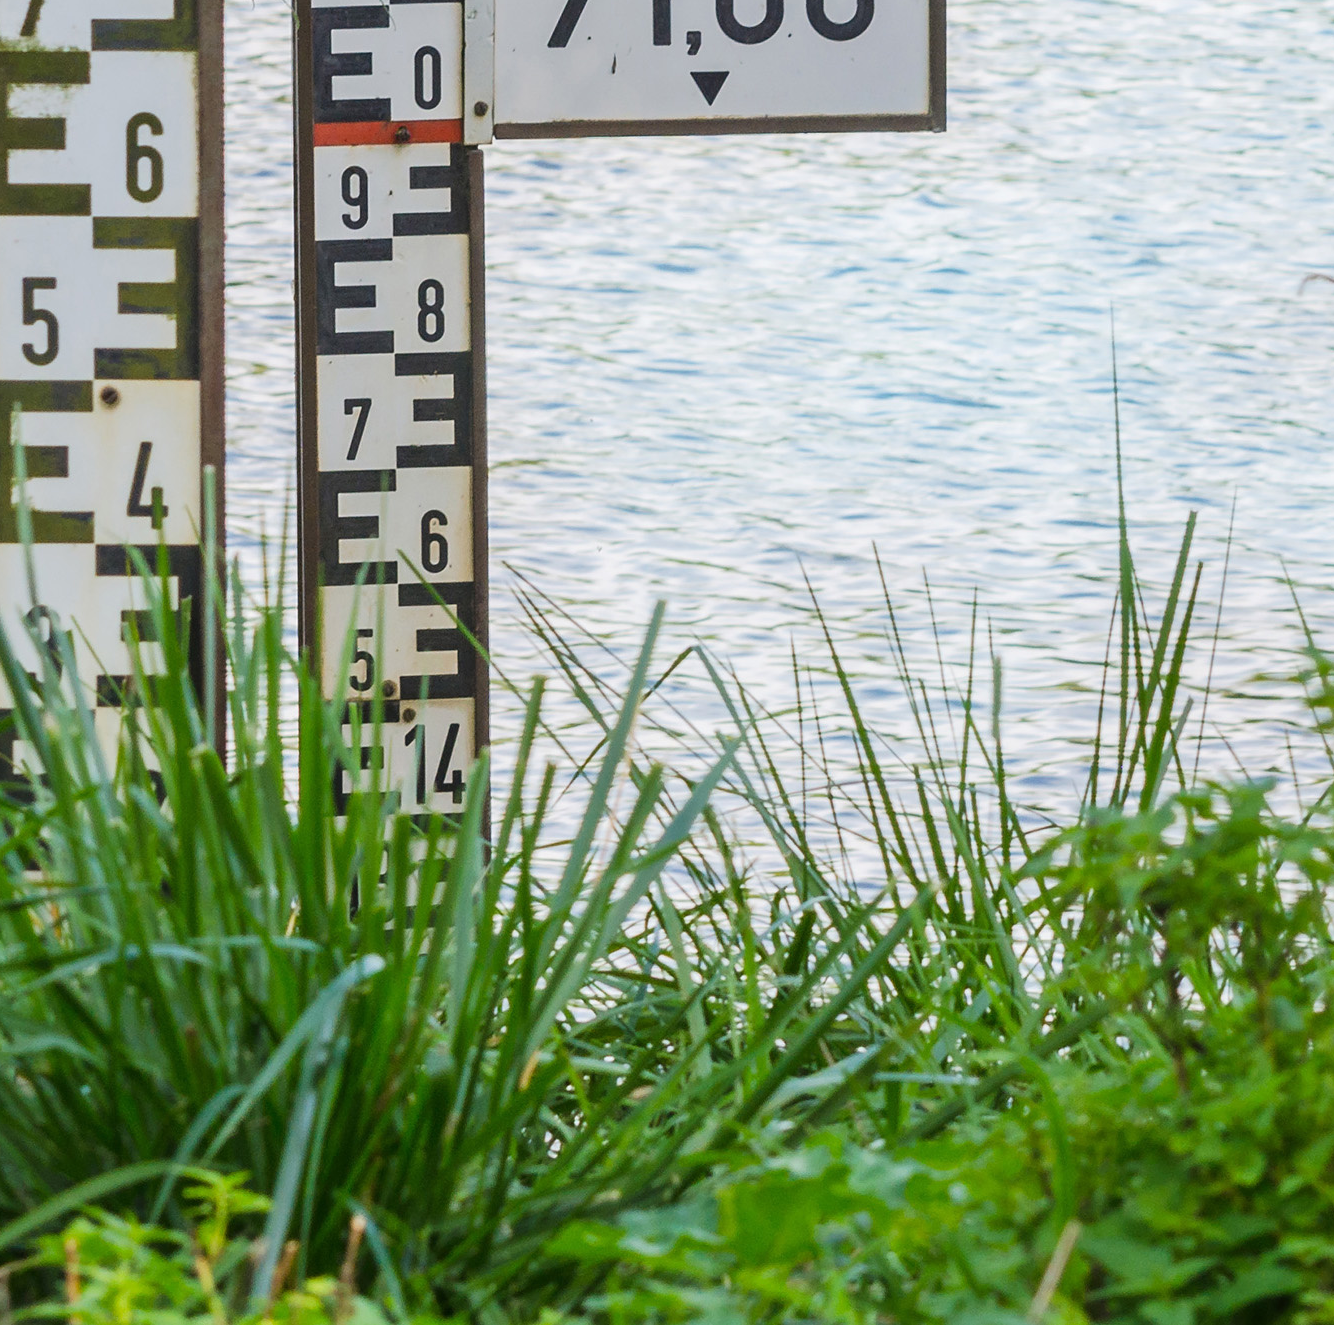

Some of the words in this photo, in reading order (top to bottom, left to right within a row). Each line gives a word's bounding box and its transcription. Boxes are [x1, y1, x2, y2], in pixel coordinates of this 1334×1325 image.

[414, 45, 442, 110] 0
[125, 112, 165, 203] 6
[341, 166, 368, 230] 9
[21, 277, 59, 366] 5
[417, 279, 445, 343] 8
[344, 398, 372, 460] 7
[126, 441, 168, 530] 4
[420, 510, 449, 573] 6
[349, 629, 375, 691] 5
[404, 723, 466, 804] 14
